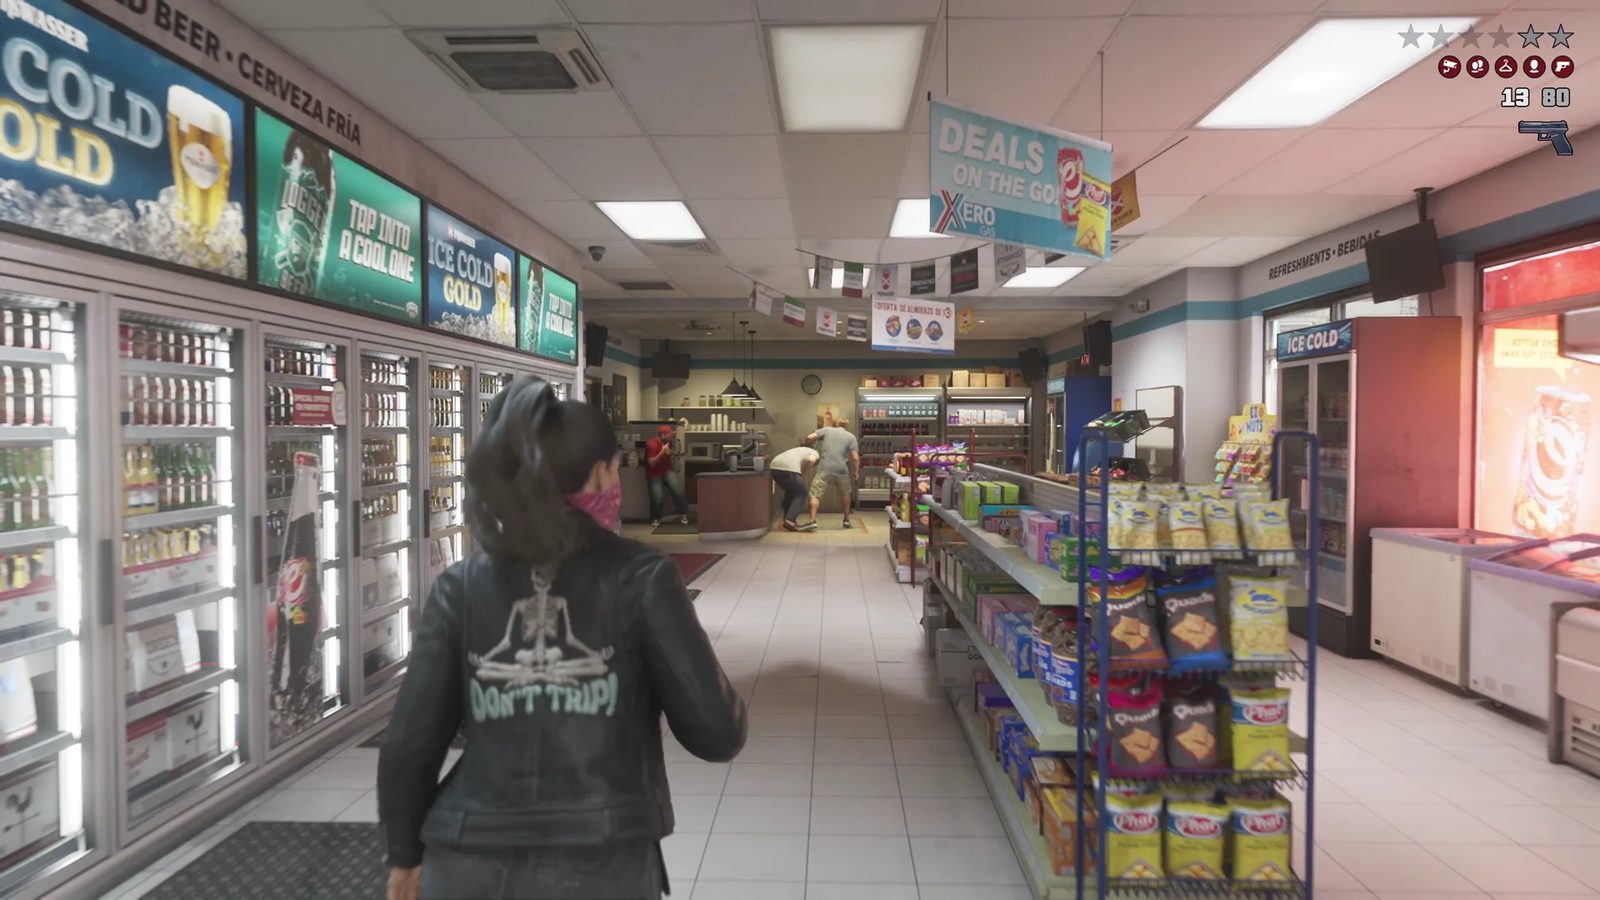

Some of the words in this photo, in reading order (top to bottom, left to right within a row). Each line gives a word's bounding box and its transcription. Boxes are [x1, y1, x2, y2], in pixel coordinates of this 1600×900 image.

[2, 37, 163, 149] COLD
[154, 0, 220, 62] BEER
[238, 52, 324, 123] CERVEZA
[326, 106, 361, 146] FRÍA
[938, 117, 1045, 175] DEALS
[953, 162, 982, 189] ON
[988, 171, 1025, 199] THE
[350, 199, 377, 236] TAP
[378, 212, 411, 251] INTO
[934, 189, 996, 234] XERO
[979, 226, 996, 237] GAS
[339, 229, 353, 261] A
[352, 235, 388, 275] COOL
[388, 251, 415, 284] ONE
[427, 236, 455, 274] ICE
[457, 248, 493, 289] COLD
[1269, 248, 1331, 281] REFRESHMENTS
[443, 275, 482, 312] GOLD
[1287, 333, 1305, 354] ICE
[1307, 328, 1339, 350] COLD
[469, 677, 542, 722] DON'T
[544, 672, 619, 717] TRIP!
